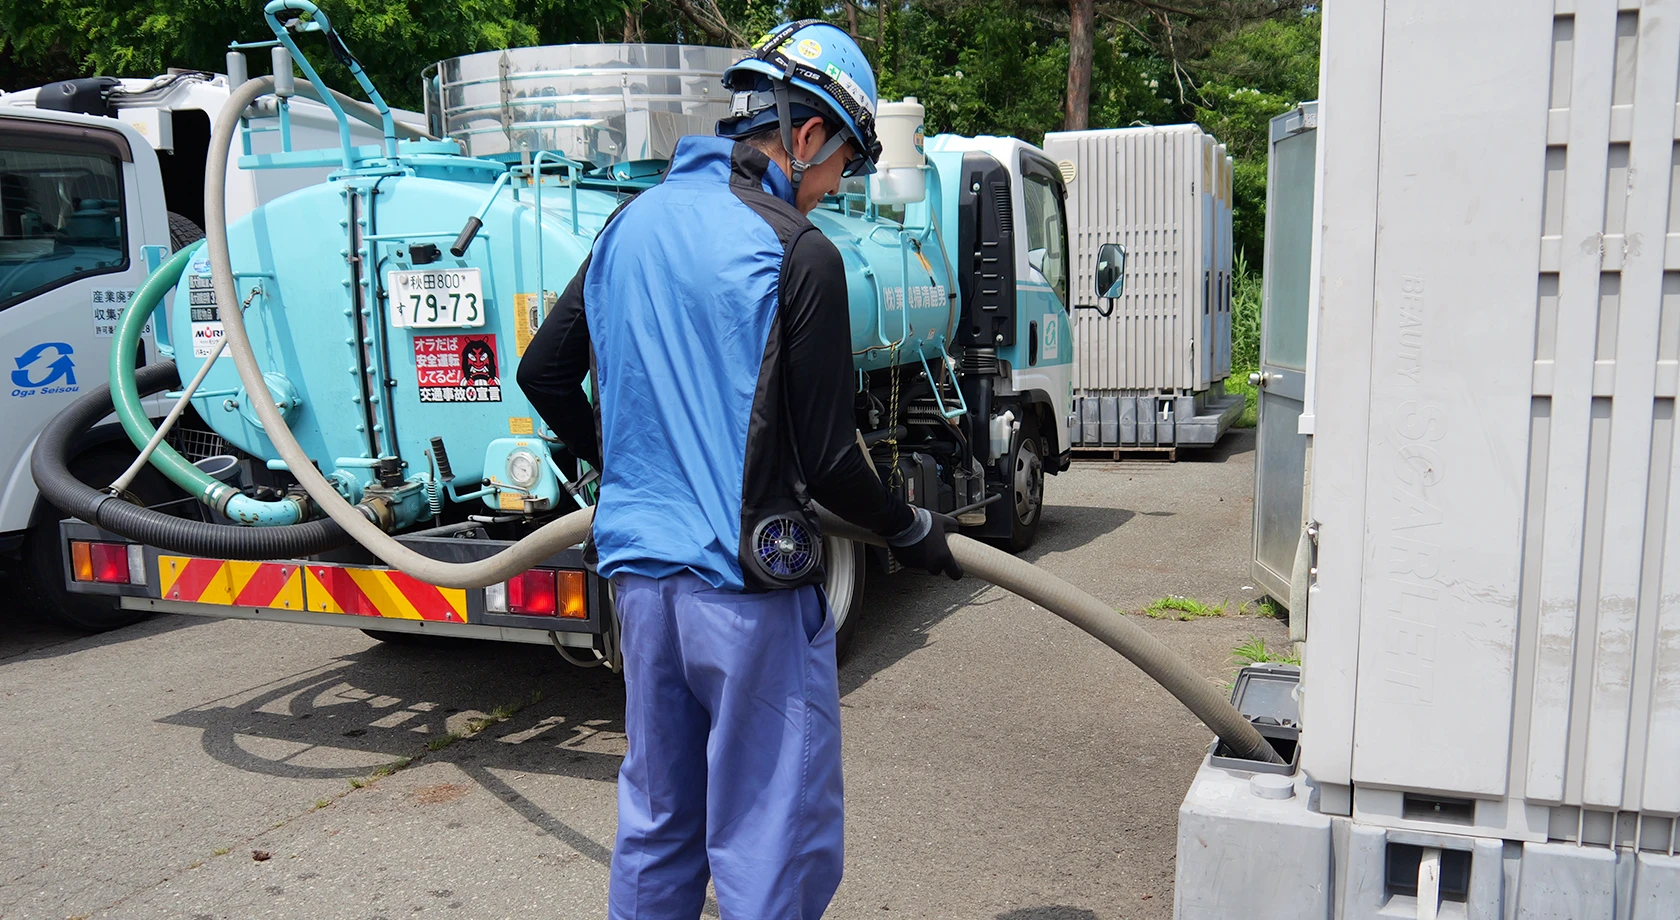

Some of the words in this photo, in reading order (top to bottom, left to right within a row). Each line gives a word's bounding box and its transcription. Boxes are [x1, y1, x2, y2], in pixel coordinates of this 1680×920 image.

[762, 27, 794, 52] GENTOS
[775, 56, 821, 80] GTOS
[396, 301, 406, 315] す
[409, 292, 478, 323] 79-73
[1396, 273, 1425, 384] BEAUTY
[414, 338, 459, 352] オラだば
[416, 354, 460, 367] 安全運転
[11, 389, 36, 398] Oga
[40, 386, 80, 395] Seisou
[1384, 400, 1448, 707] SCARLET
